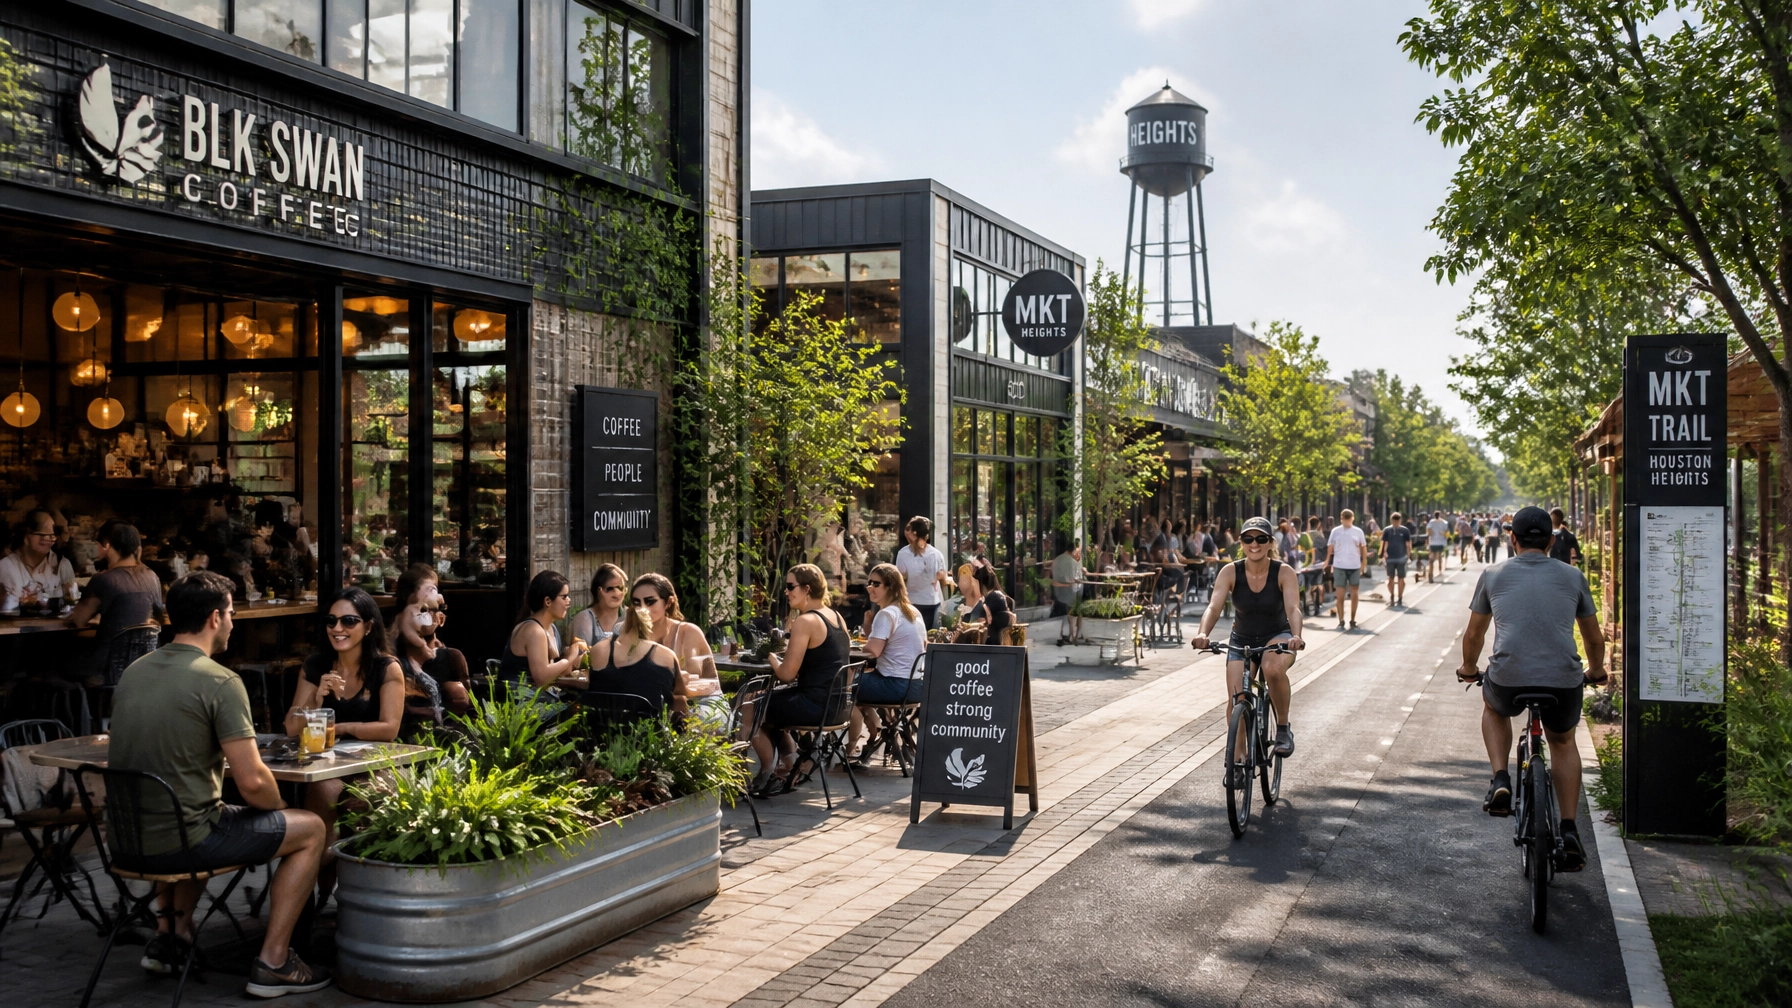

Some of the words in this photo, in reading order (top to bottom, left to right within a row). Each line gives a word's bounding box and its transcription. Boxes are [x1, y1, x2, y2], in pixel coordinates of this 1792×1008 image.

[1130, 120, 1197, 147] HEIGHTS
[184, 94, 256, 176] BLK
[270, 120, 363, 201] SWAN
[1015, 294, 1072, 325] MKT
[1021, 327, 1067, 338] HEIGHTS
[1649, 370, 1711, 406] MKT
[602, 416, 641, 436] COFFEE
[1648, 414, 1712, 441] TRAIL
[1650, 455, 1712, 469] HOUSTON
[604, 463, 642, 482] PEOPLE
[955, 660, 990, 678] good
[949, 680, 994, 697] coffee
[946, 701, 993, 721] strong
[931, 723, 1007, 744] community
